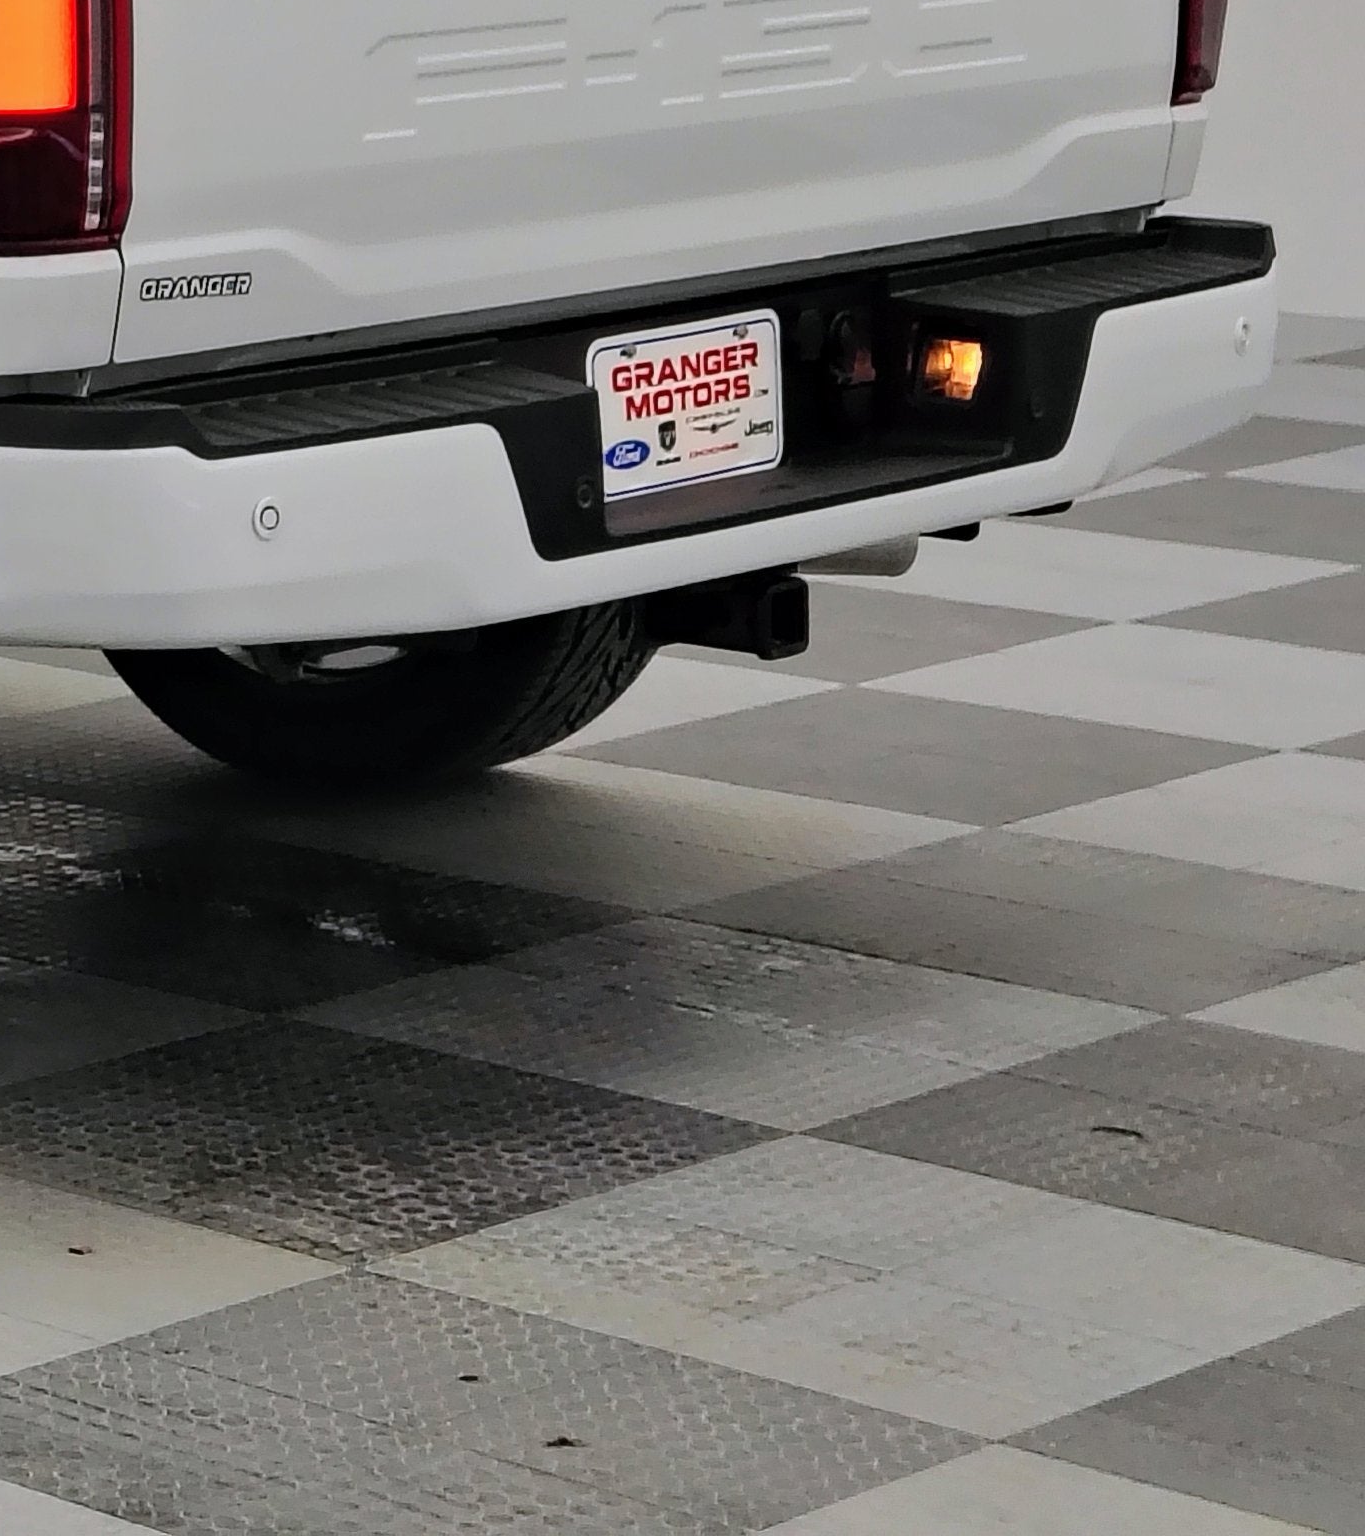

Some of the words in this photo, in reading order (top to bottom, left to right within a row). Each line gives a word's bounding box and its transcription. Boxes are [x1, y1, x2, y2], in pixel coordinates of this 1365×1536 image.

[140, 273, 252, 301] GRANGER
[612, 342, 758, 392] GRANGER
[625, 374, 750, 421] MOTORS
